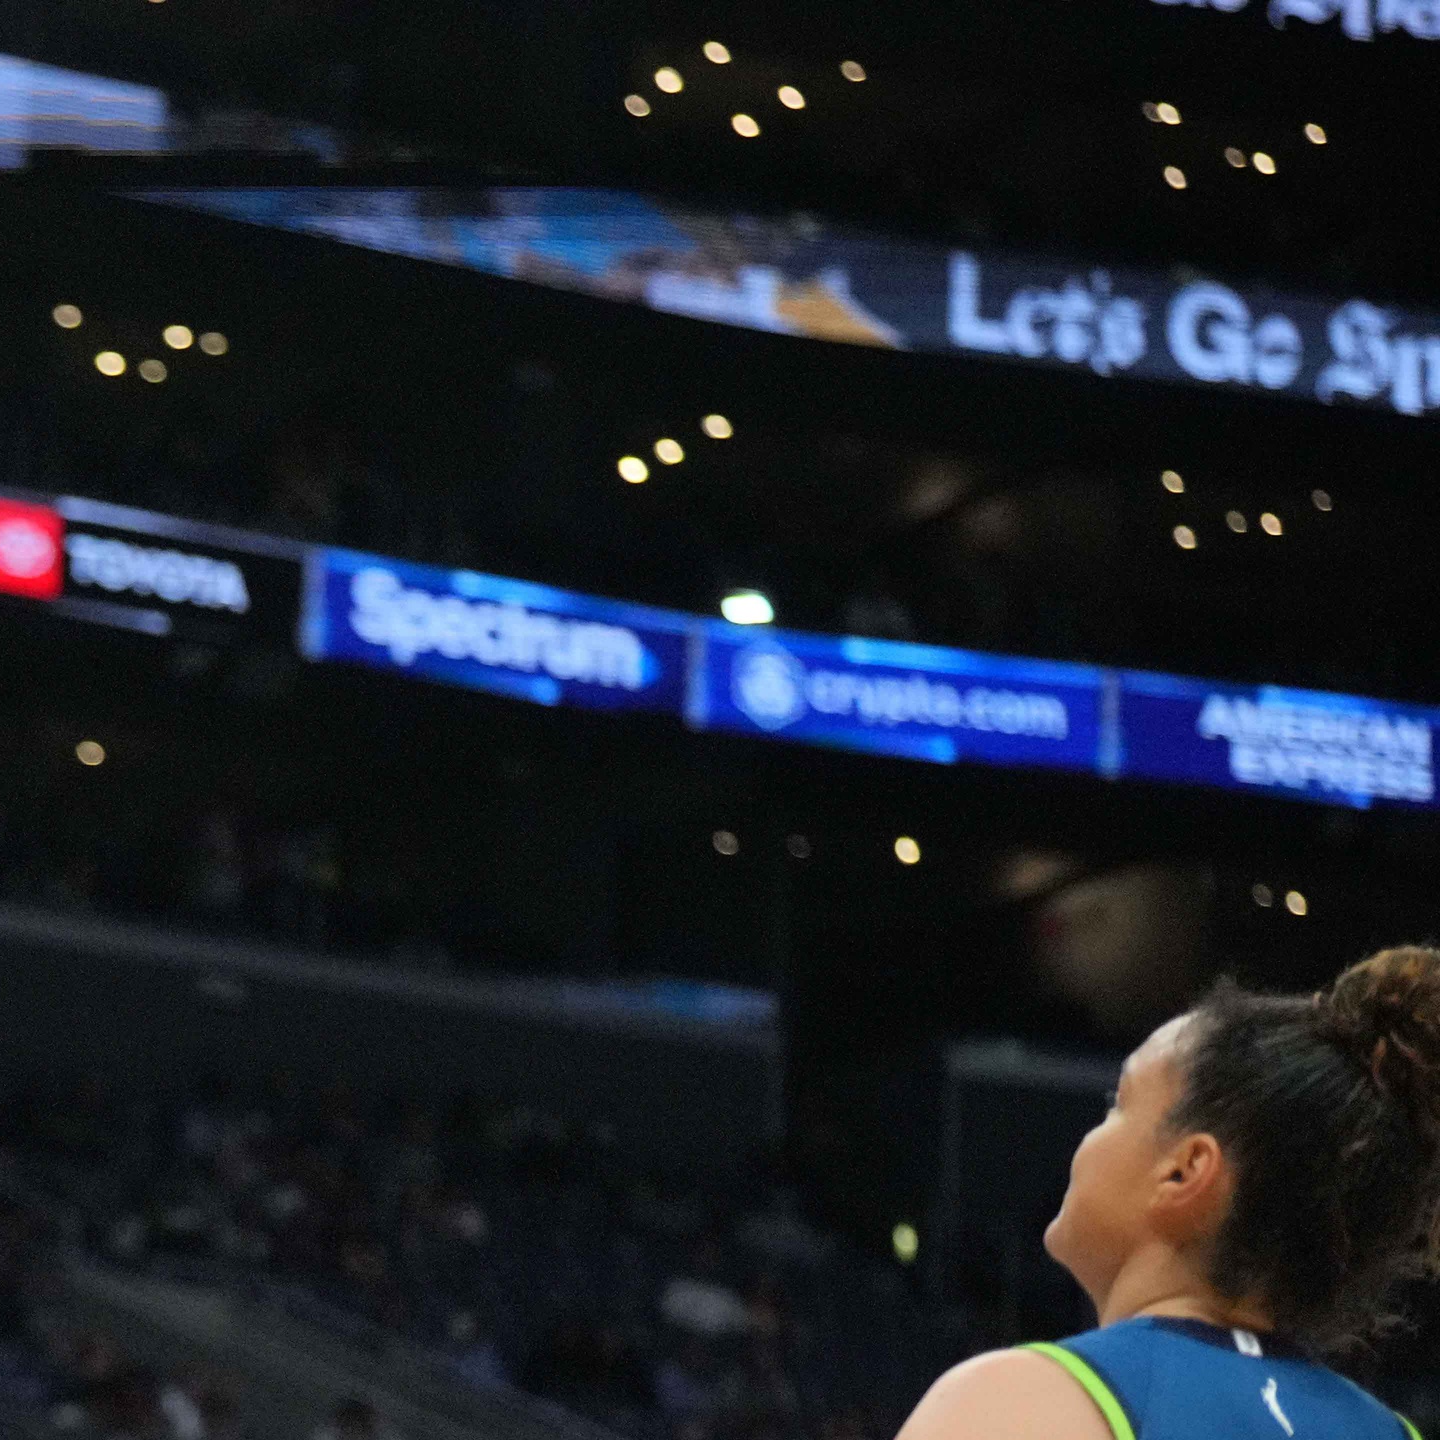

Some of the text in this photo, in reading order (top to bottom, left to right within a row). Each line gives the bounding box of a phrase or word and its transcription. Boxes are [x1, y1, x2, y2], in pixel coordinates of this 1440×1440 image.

[947, 252, 1145, 376] Let's
[1166, 280, 1302, 390] Go
[66, 532, 250, 613] TOYOTA
[350, 567, 648, 690] Spectrum
[808, 668, 1069, 740] crypto.com
